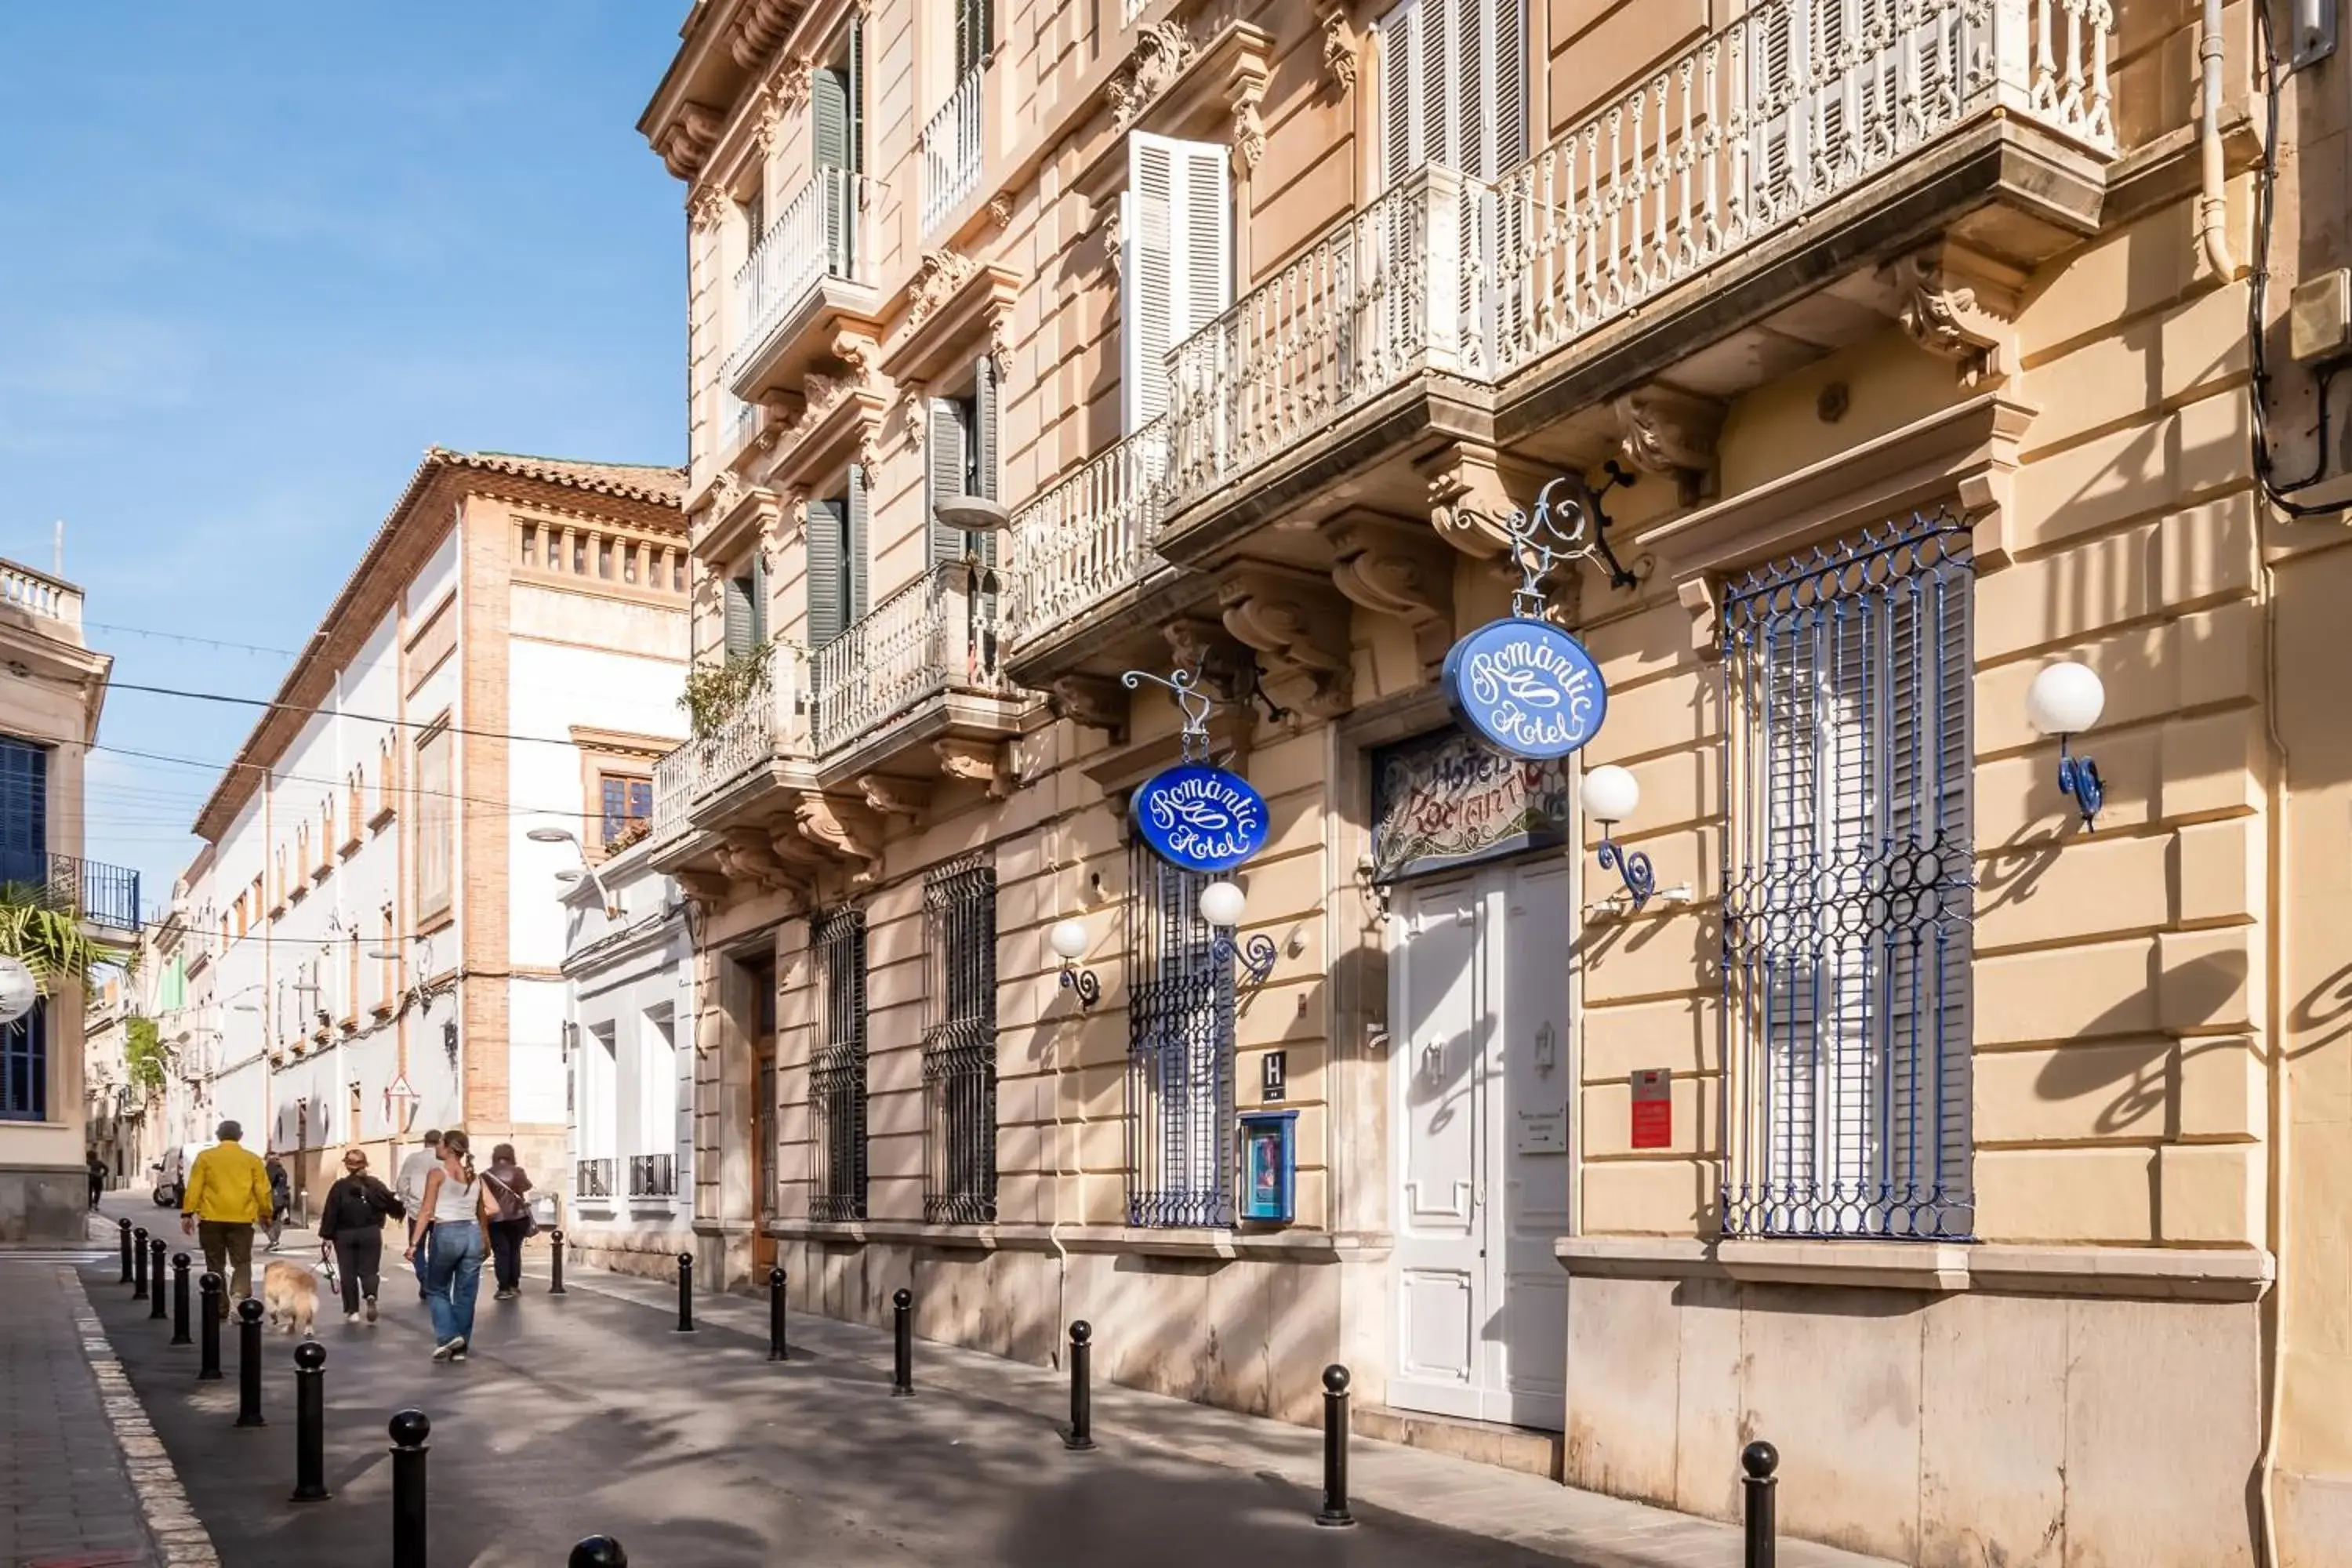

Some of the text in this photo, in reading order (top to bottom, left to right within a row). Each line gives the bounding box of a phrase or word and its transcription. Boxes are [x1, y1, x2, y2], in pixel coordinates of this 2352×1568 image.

[1491, 699, 1585, 745] Hotel
[1168, 825, 1250, 860] Hotel
[1266, 1054, 1281, 1086] H
